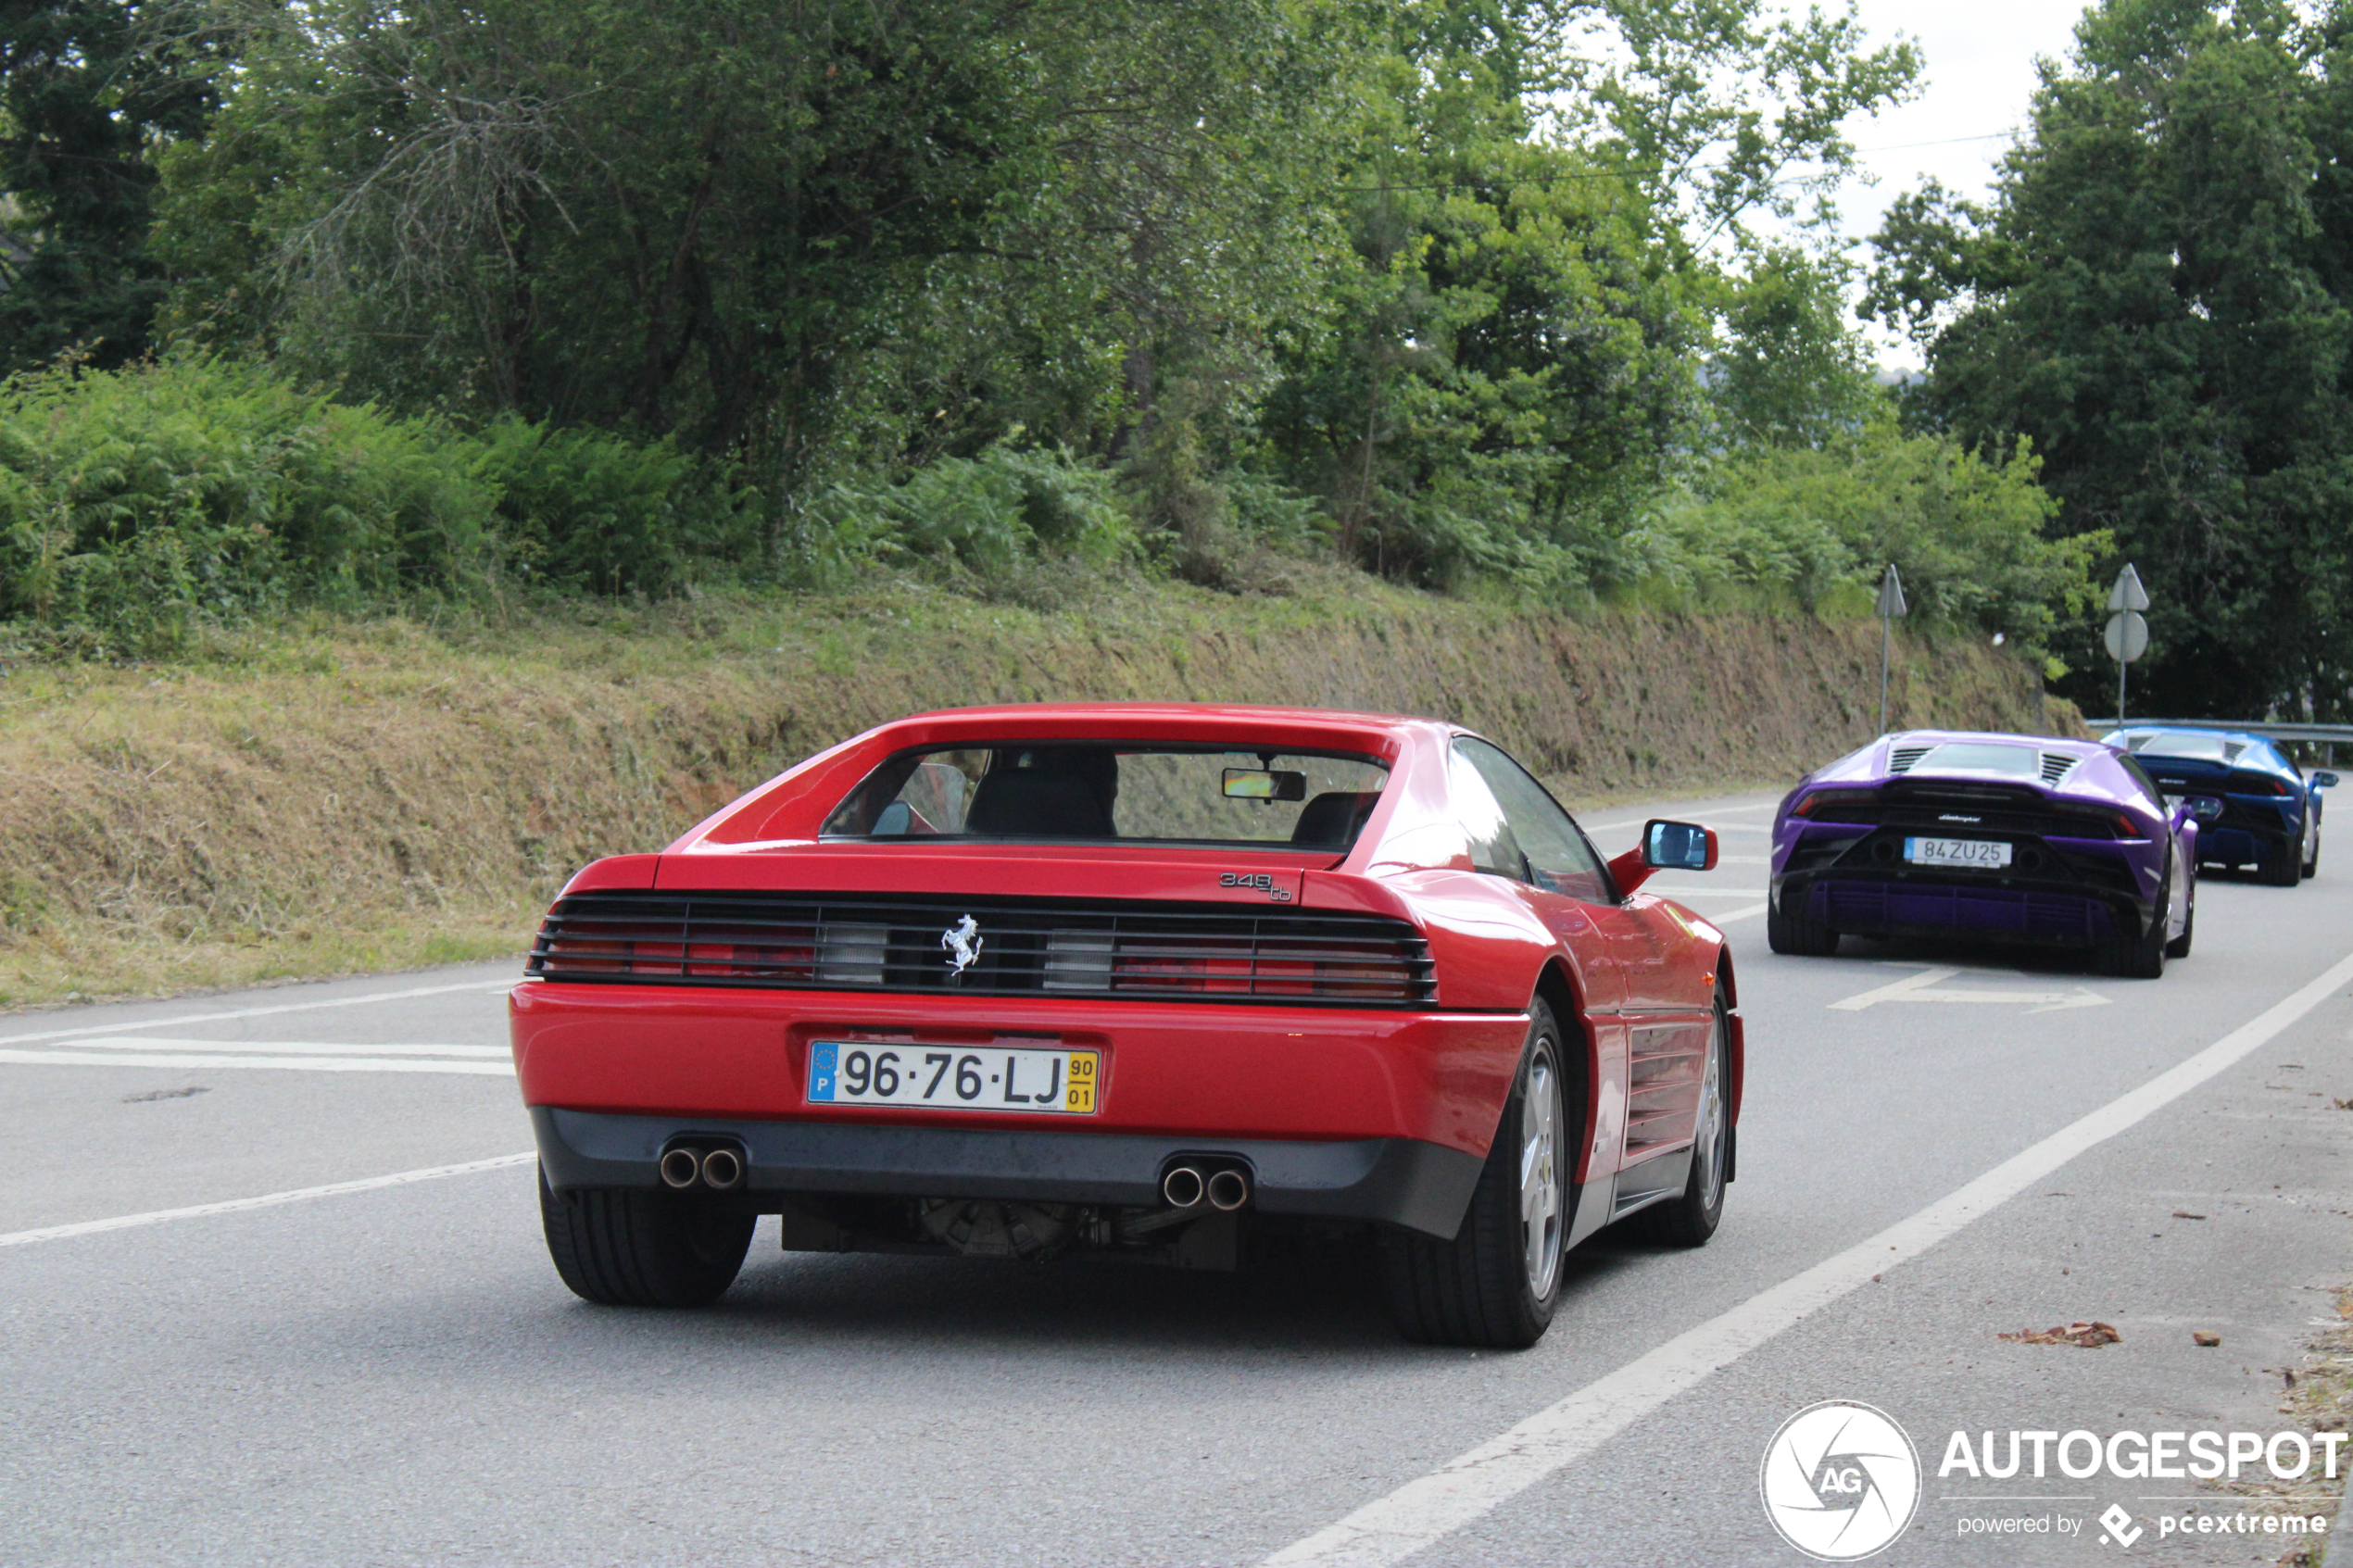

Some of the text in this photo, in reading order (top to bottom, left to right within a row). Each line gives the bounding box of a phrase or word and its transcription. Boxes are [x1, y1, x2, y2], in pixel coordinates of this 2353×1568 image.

[1219, 872, 1272, 887] 348
[1070, 1060, 1093, 1076] 90
[817, 1077, 828, 1092] P
[1068, 1089, 1089, 1106] 01
